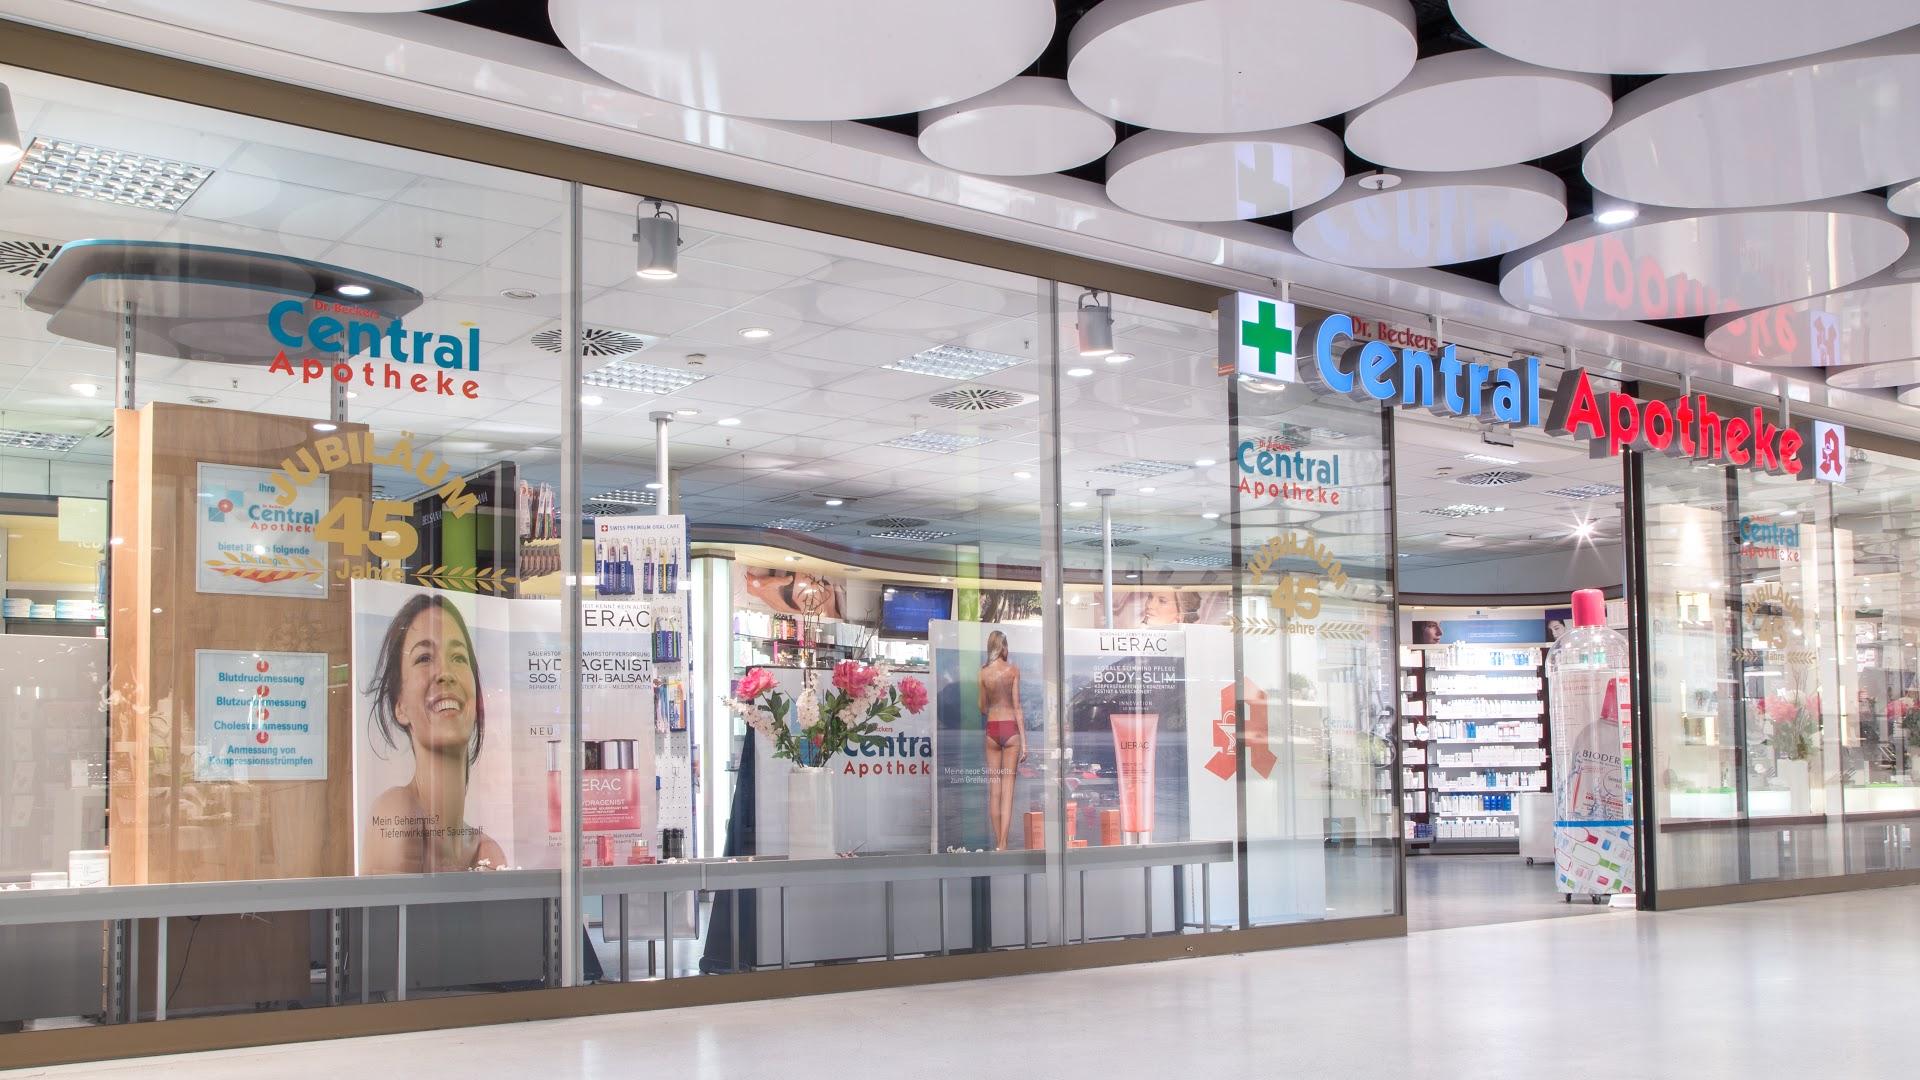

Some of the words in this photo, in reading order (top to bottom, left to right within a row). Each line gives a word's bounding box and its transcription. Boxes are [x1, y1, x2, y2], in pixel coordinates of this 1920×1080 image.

[267, 300, 480, 372] Central
[1352, 317, 1372, 338] Dr.
[1378, 321, 1439, 352] Beckers
[268, 350, 480, 399] Apotheke
[1315, 313, 1541, 426] Central
[1564, 369, 1804, 475] Apotheke
[1237, 441, 1340, 486] Central
[271, 430, 480, 519] JUBILÄUM
[258, 483, 276, 493] Ihre
[1238, 476, 1340, 506] Apotheke
[248, 504, 320, 525] Central
[250, 522, 316, 534] Apothek
[313, 496, 419, 561] 45
[1739, 516, 1799, 548] Central
[273, 545, 310, 556] folgende
[1740, 546, 1800, 562] Apotheke
[1249, 530, 1349, 589] JUBILÄUM
[336, 558, 406, 582] Jahre
[1270, 575, 1321, 620] 45
[585, 610, 650, 627] ERAC
[1099, 637, 1167, 651] LIERAC
[528, 659, 650, 671] HYDAGENIST
[218, 672, 305, 686] Blutdruckmessung
[529, 674, 556, 683] SOS
[1093, 672, 1176, 683] BODY-SLIM
[530, 727, 554, 736] NEU
[227, 745, 278, 756] Anmessung
[844, 760, 930, 778] Apothek
[582, 778, 621, 791] ERAC
[372, 816, 392, 826] Mein
[394, 815, 440, 826] Geheimnis?
[446, 826, 484, 836] Sauerstoff
